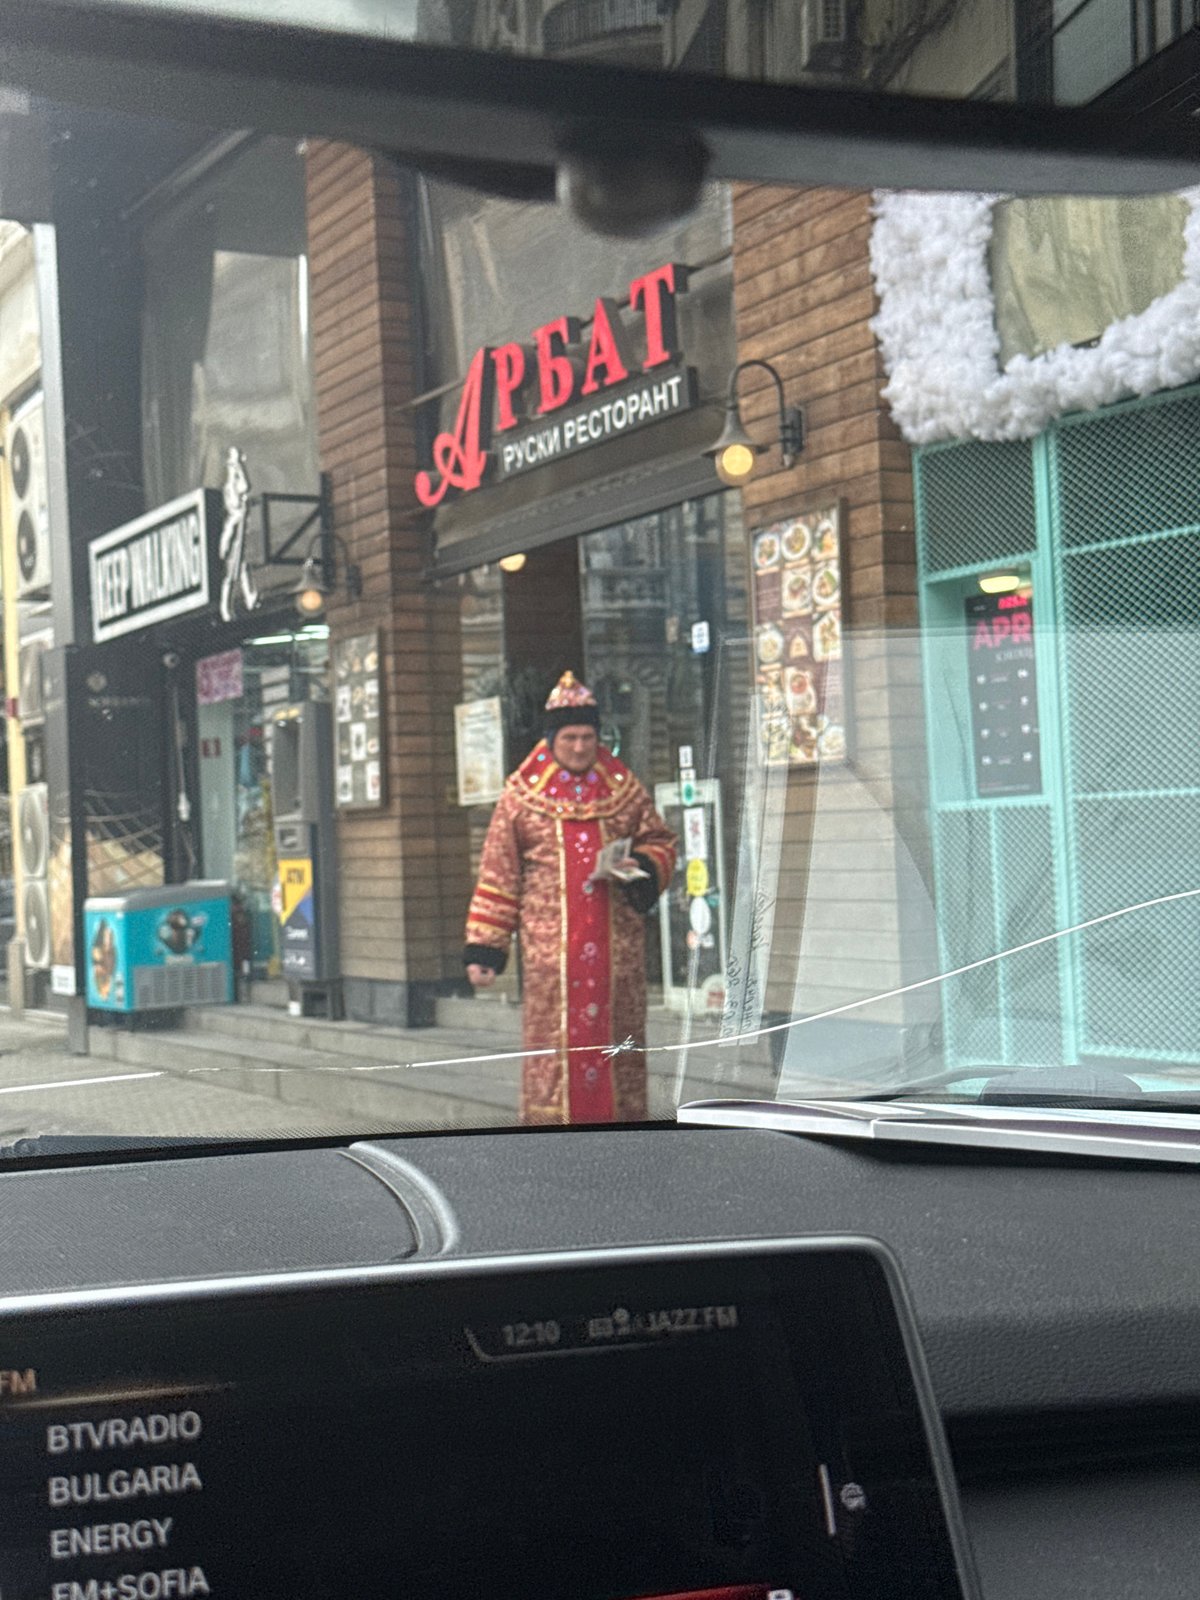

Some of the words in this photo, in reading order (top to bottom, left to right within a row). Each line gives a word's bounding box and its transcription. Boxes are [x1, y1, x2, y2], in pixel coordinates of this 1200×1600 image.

[415, 263, 676, 507] АРБАТ
[502, 425, 560, 472] РУСКИ
[563, 376, 682, 448] РЕСТОРАНТ
[47, 1410, 201, 1452] BTVRADIO
[49, 1462, 203, 1506] BULGARIA
[50, 1517, 173, 1558] ENERGY
[51, 1566, 210, 1600] FM+SOFIA
